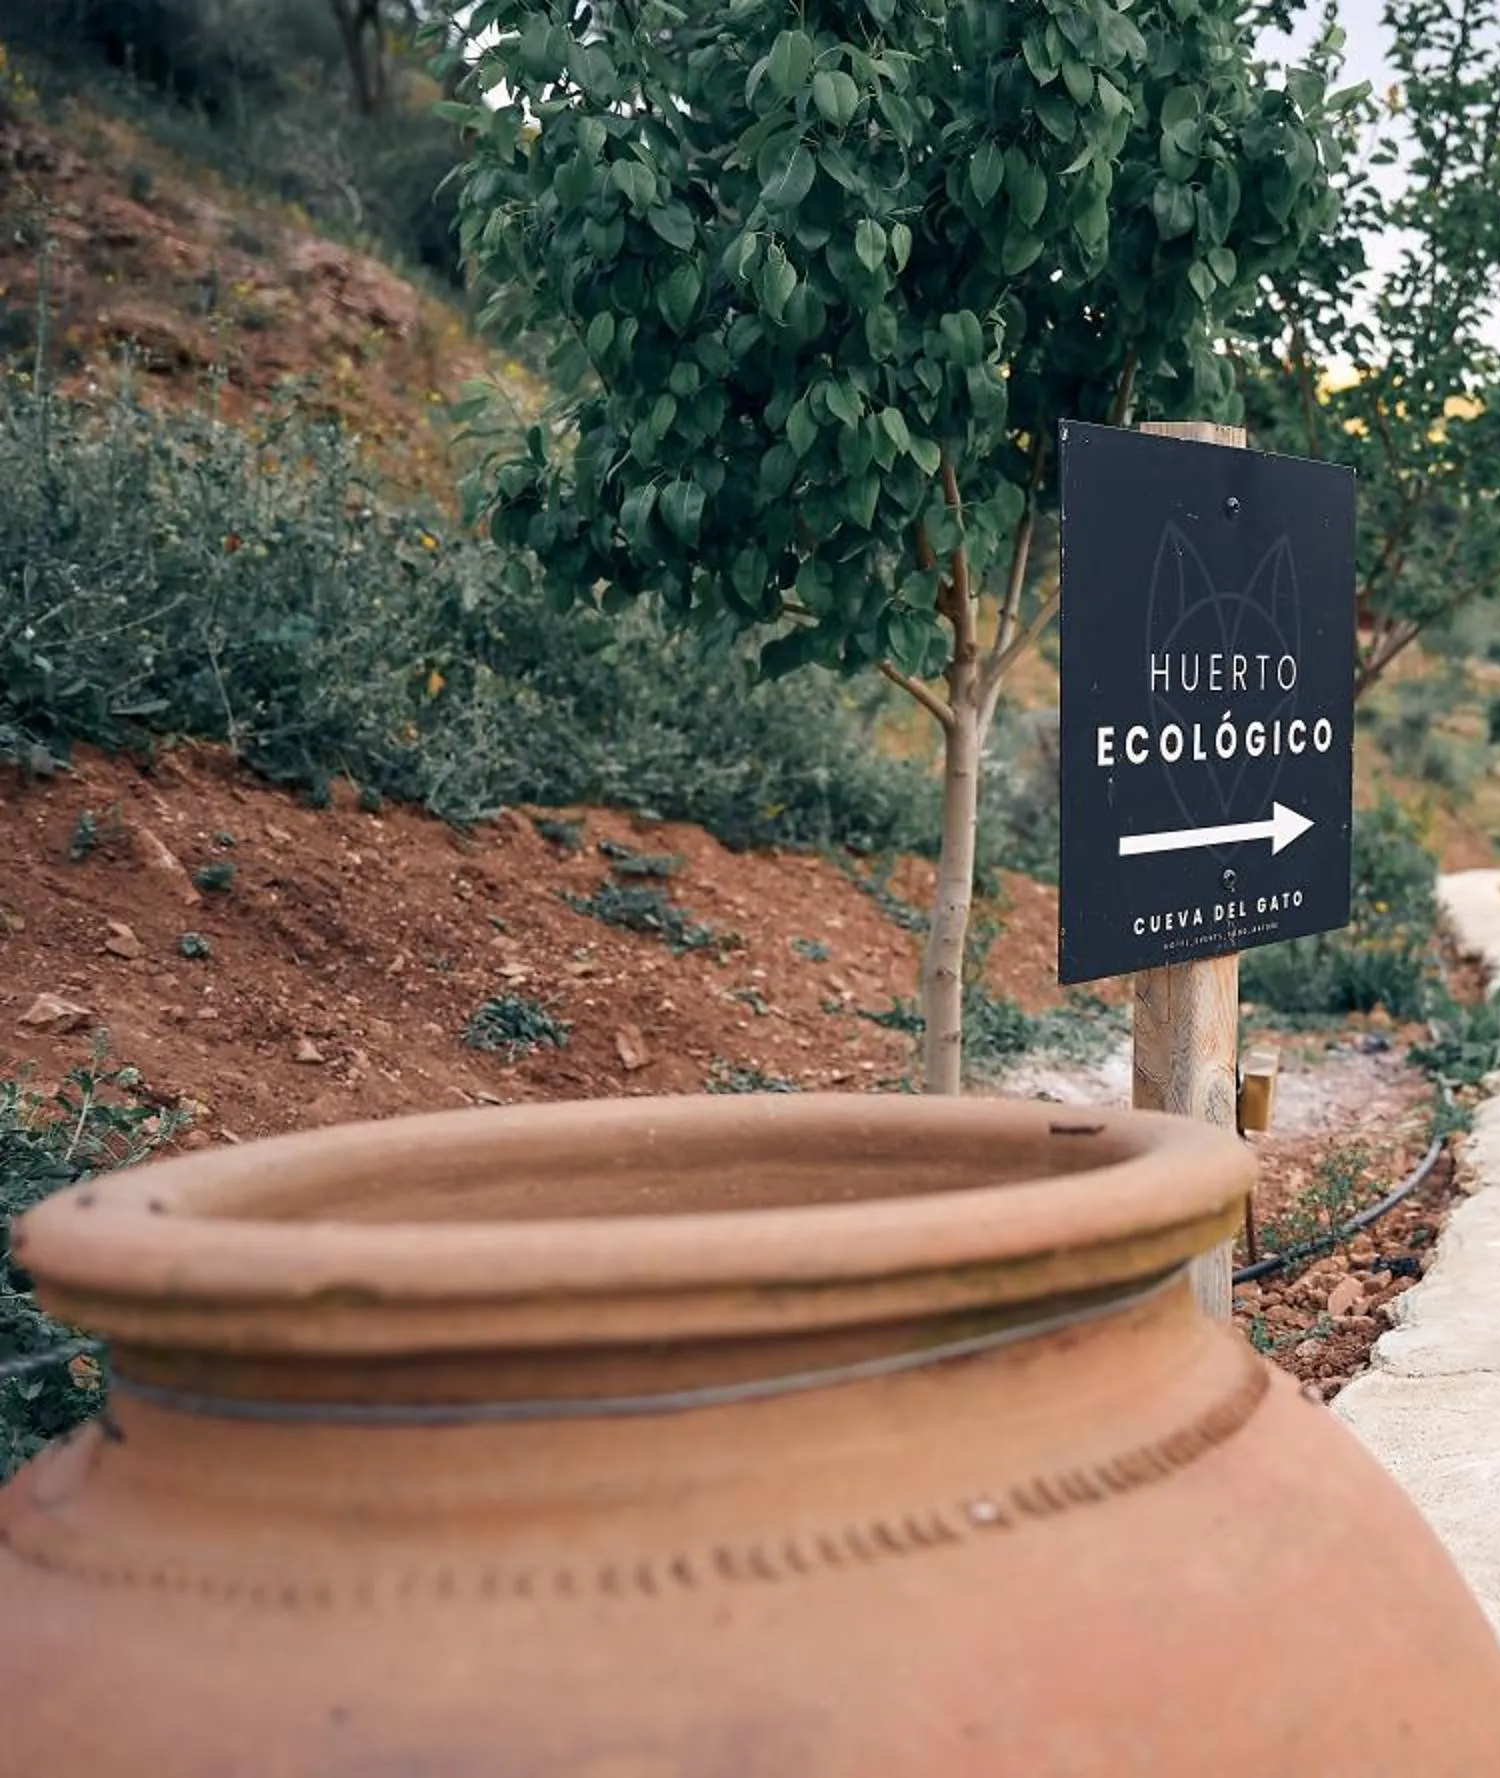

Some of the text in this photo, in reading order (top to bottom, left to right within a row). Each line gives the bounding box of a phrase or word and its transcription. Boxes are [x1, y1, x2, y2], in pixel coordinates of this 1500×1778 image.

[1150, 653, 1297, 691] HUERTO
[1097, 711, 1332, 766] ECOLÓGICO
[1133, 890, 1304, 934] CUEVA DEL GATO
